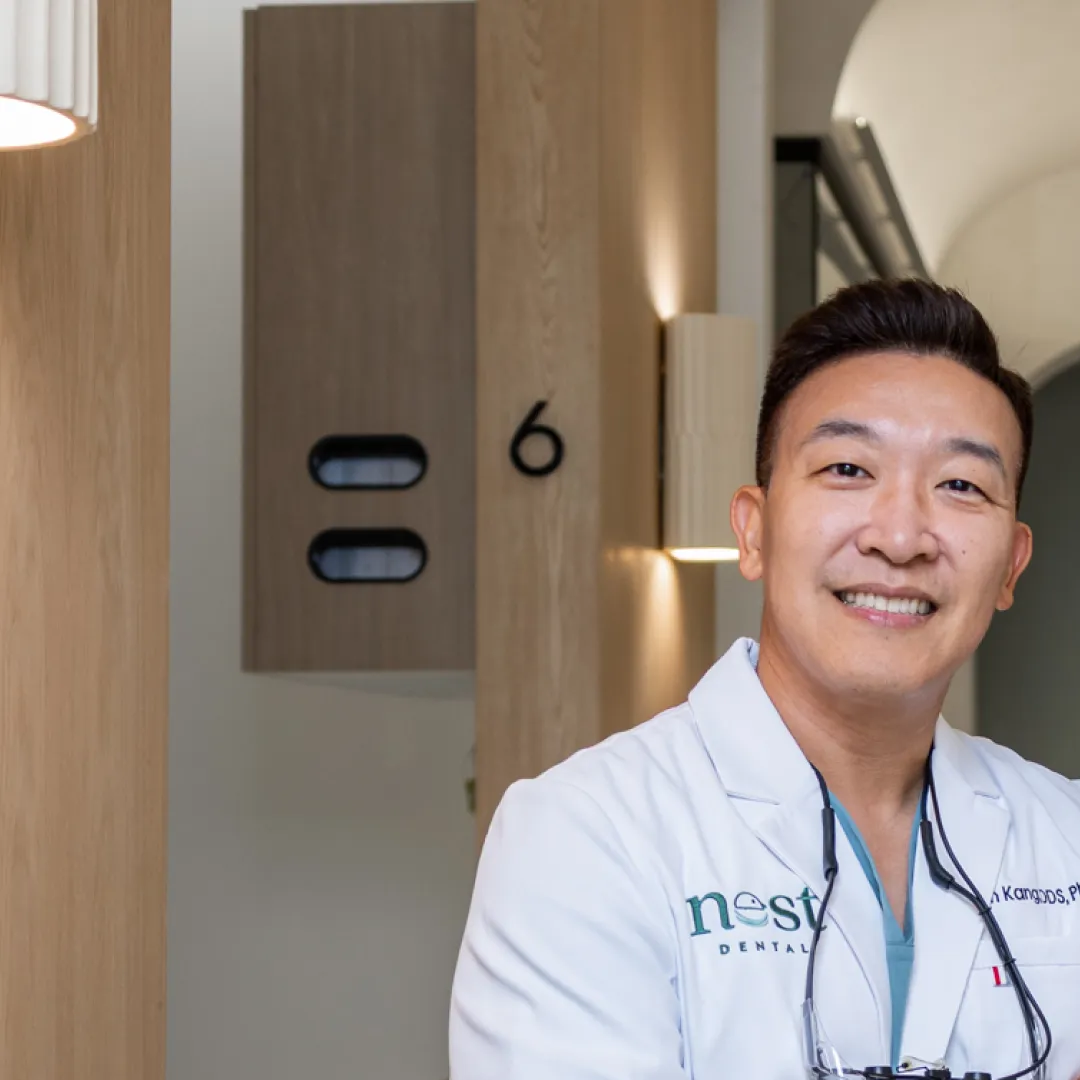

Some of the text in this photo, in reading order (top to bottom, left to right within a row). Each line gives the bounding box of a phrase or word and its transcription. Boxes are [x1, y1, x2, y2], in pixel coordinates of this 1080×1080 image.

[508, 399, 565, 478] 6
[685, 886, 828, 937] nest
[719, 941, 809, 955] DENTAL
